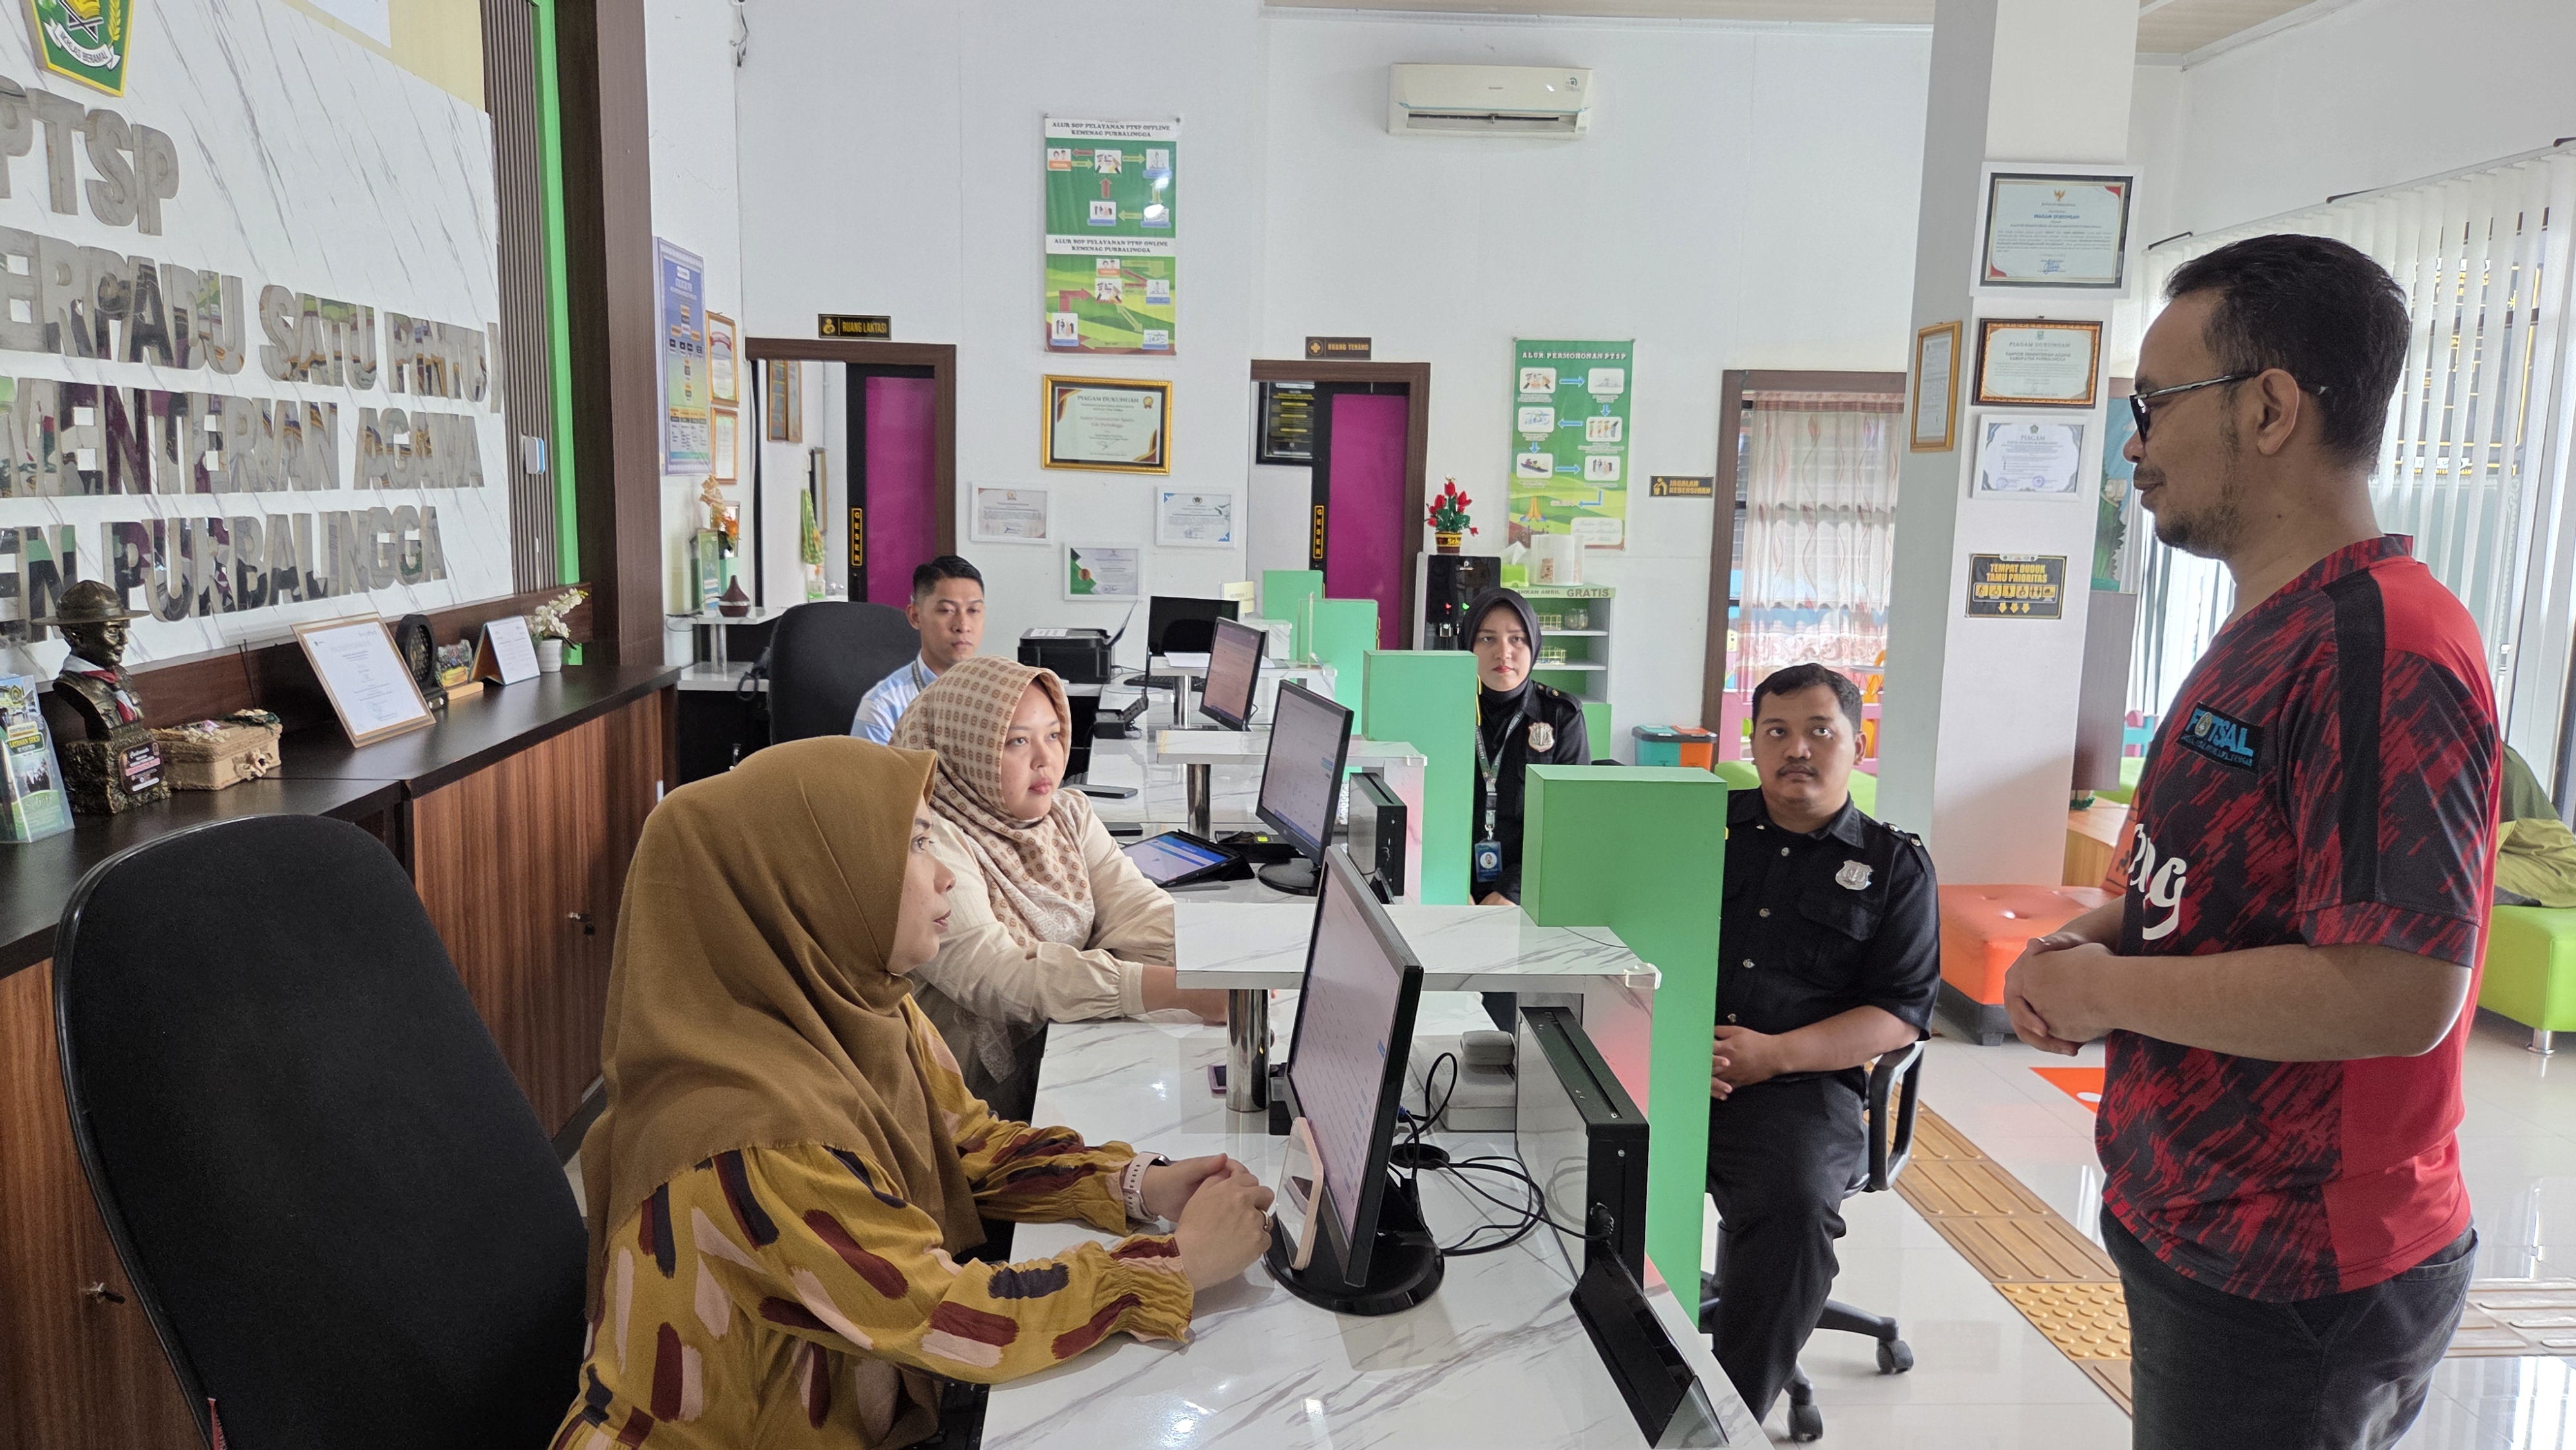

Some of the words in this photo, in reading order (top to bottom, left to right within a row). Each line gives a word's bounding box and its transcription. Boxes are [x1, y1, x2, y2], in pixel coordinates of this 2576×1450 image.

[842, 321, 862, 332] RUANG
[863, 322, 887, 333] LAKTASI
[259, 285, 377, 390] SATU
[354, 408, 485, 491] AGAMA
[1990, 563, 2019, 573] TEMPAT
[2020, 564, 2046, 574] DUDUK
[1986, 573, 2007, 582] TAMU
[2009, 574, 2048, 583] PRIORITAS
[1566, 588, 1609, 598] GRATIS
